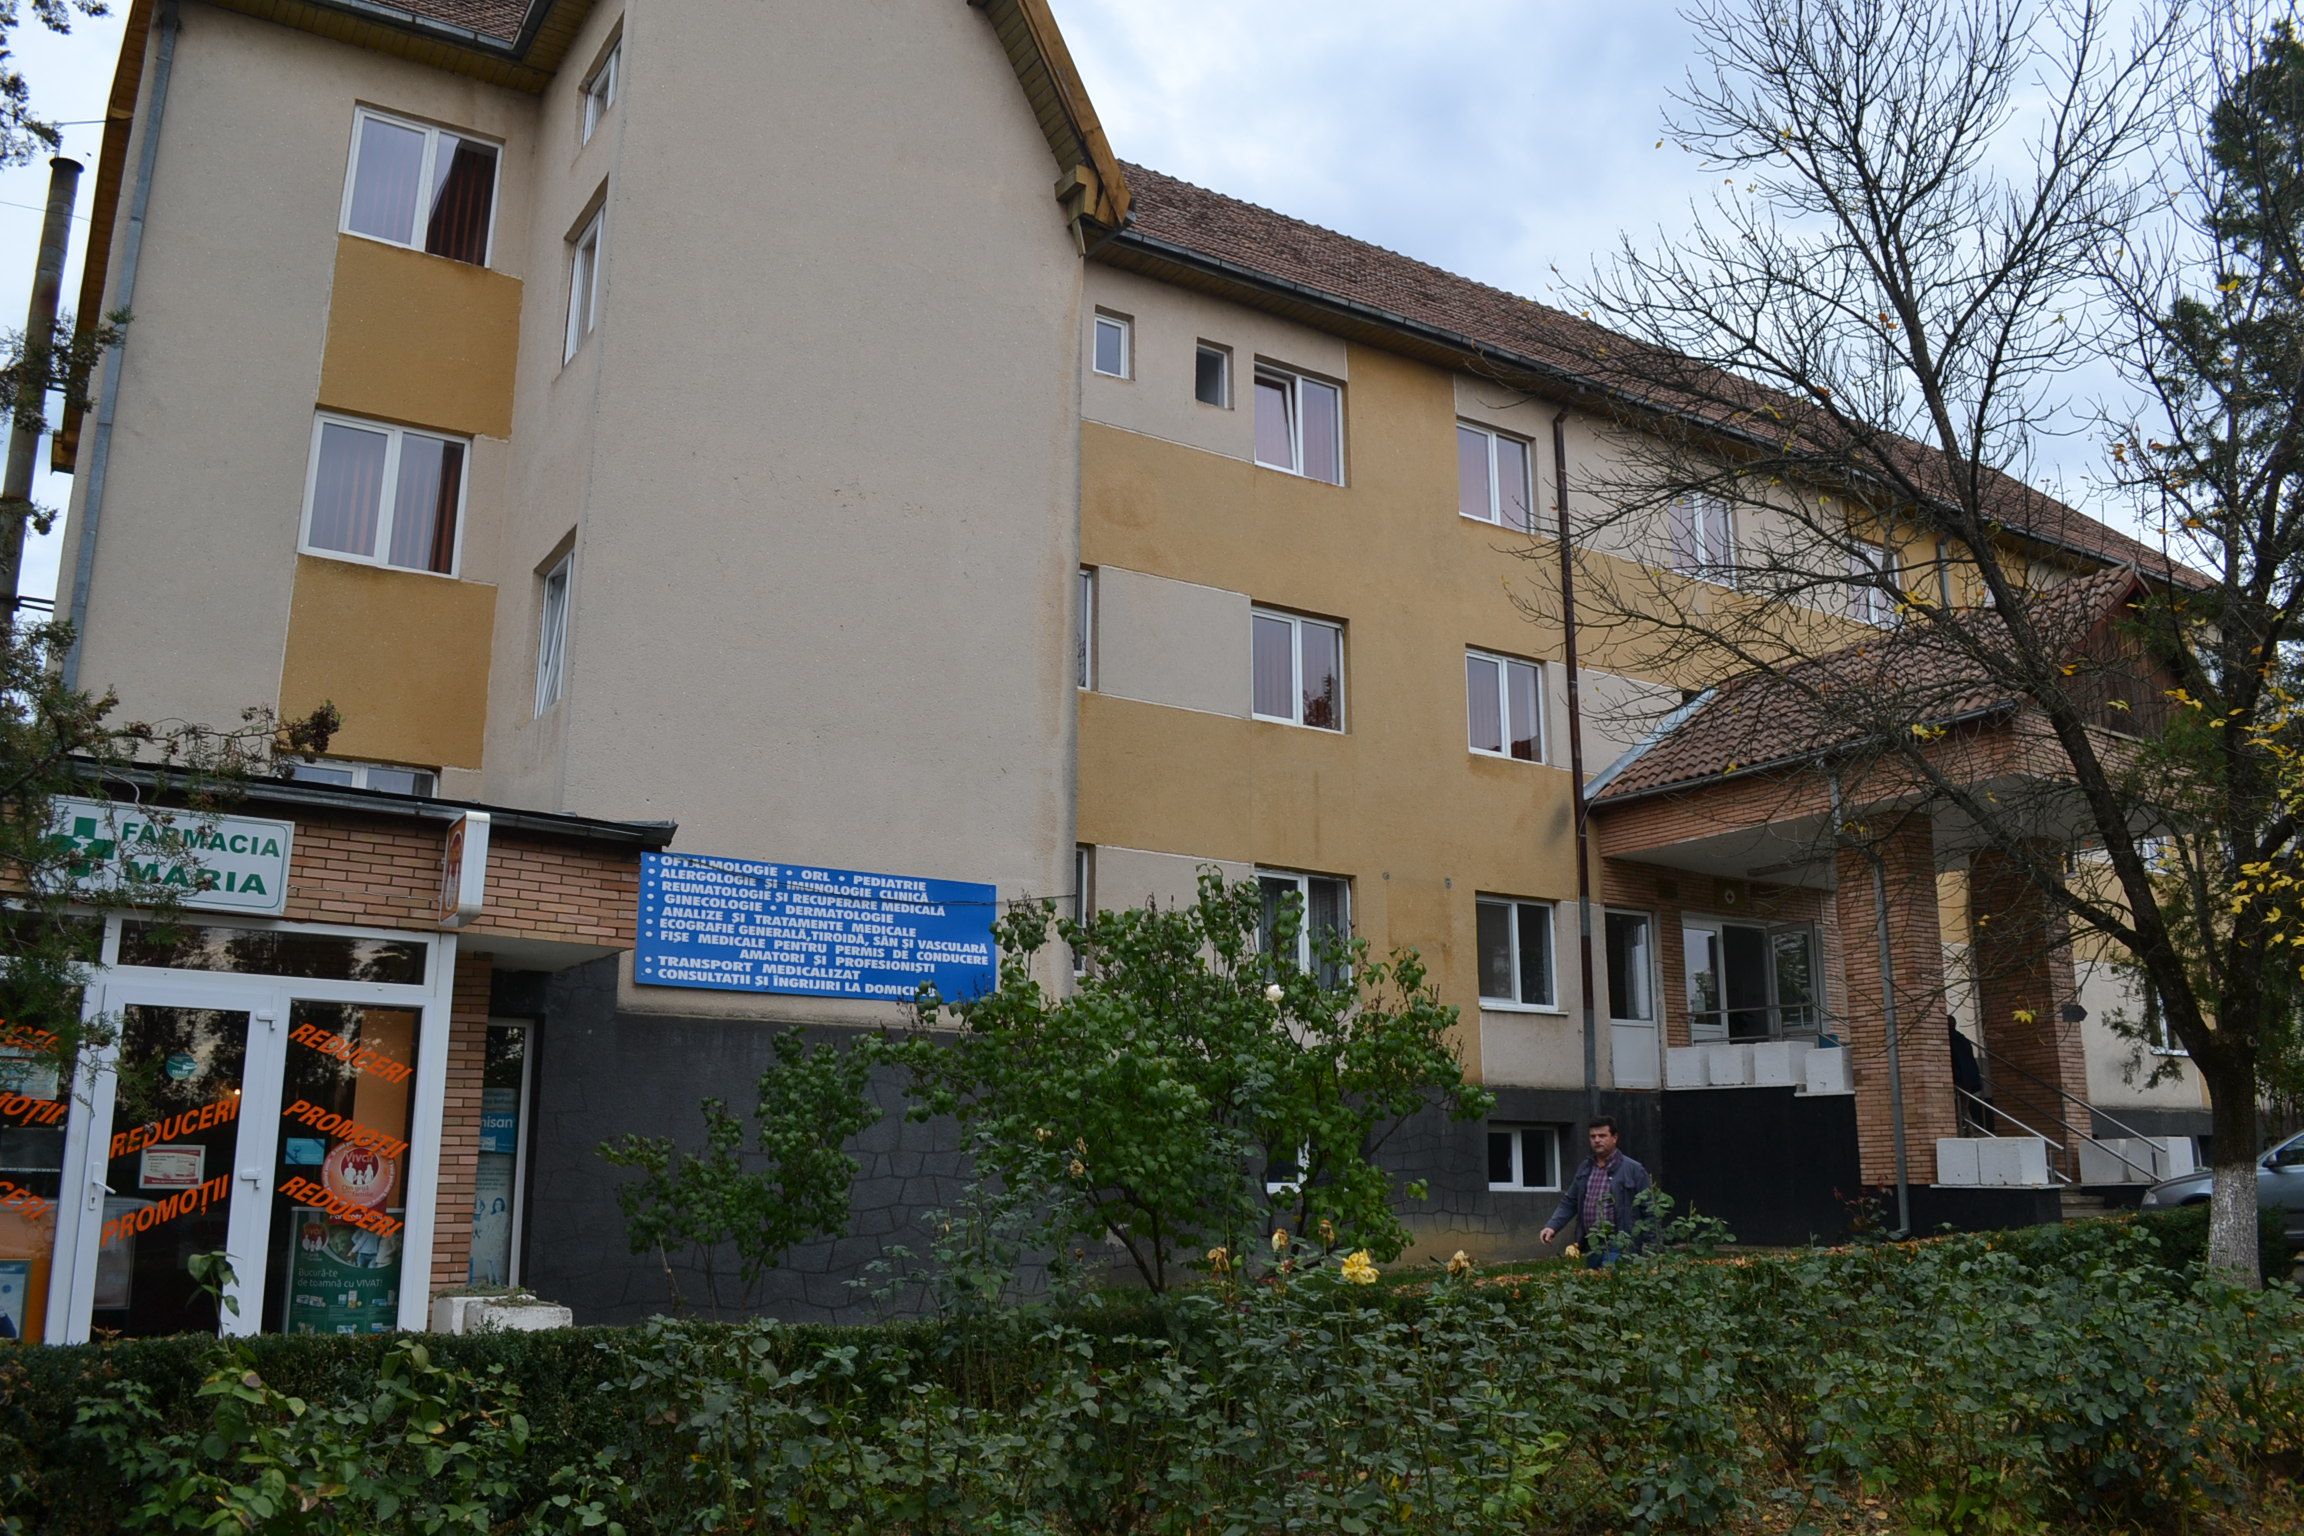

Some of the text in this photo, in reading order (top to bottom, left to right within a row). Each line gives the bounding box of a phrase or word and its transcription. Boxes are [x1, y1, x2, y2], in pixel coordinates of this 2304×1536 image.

[122, 821, 280, 858] FARMACIA
[124, 861, 267, 896] MARIA
[660, 855, 926, 891] OFTALMOLOGIE ORL PEDIATRIE
[660, 868, 756, 887] ALERGOLOGIE
[786, 880, 872, 898] IMUNOLOGIE
[879, 890, 929, 903] CLINICĂ
[661, 881, 771, 901] REUMATOLOGIE
[792, 893, 877, 911] RECUPERARE
[881, 901, 946, 917] MEDICALĂ
[664, 894, 894, 924] GINECOLOGIE DERMATOLOGIE
[659, 918, 735, 934] ECOGRAFIE
[918, 939, 988, 955] VASCULARĂ
[662, 906, 724, 921] ANALIZE
[754, 914, 843, 931] TRATAMENTE
[851, 923, 917, 938] MEDICALE
[698, 933, 766, 949] MEDICALE
[774, 939, 827, 954] PENTRU
[835, 945, 885, 958] PERMIS
[893, 949, 909, 960] DE
[916, 951, 989, 966] CONDUCERE
[739, 949, 805, 964] AMATORI
[658, 955, 861, 980] TRANSPORT MEDICALIZAT
[773, 976, 841, 991] ÎNGRIJIRI
[844, 981, 861, 993] LA
[289, 1023, 413, 1083] REDUCERI
[109, 1096, 239, 1160] REDUCERI
[278, 1176, 404, 1239] REDUCERI
